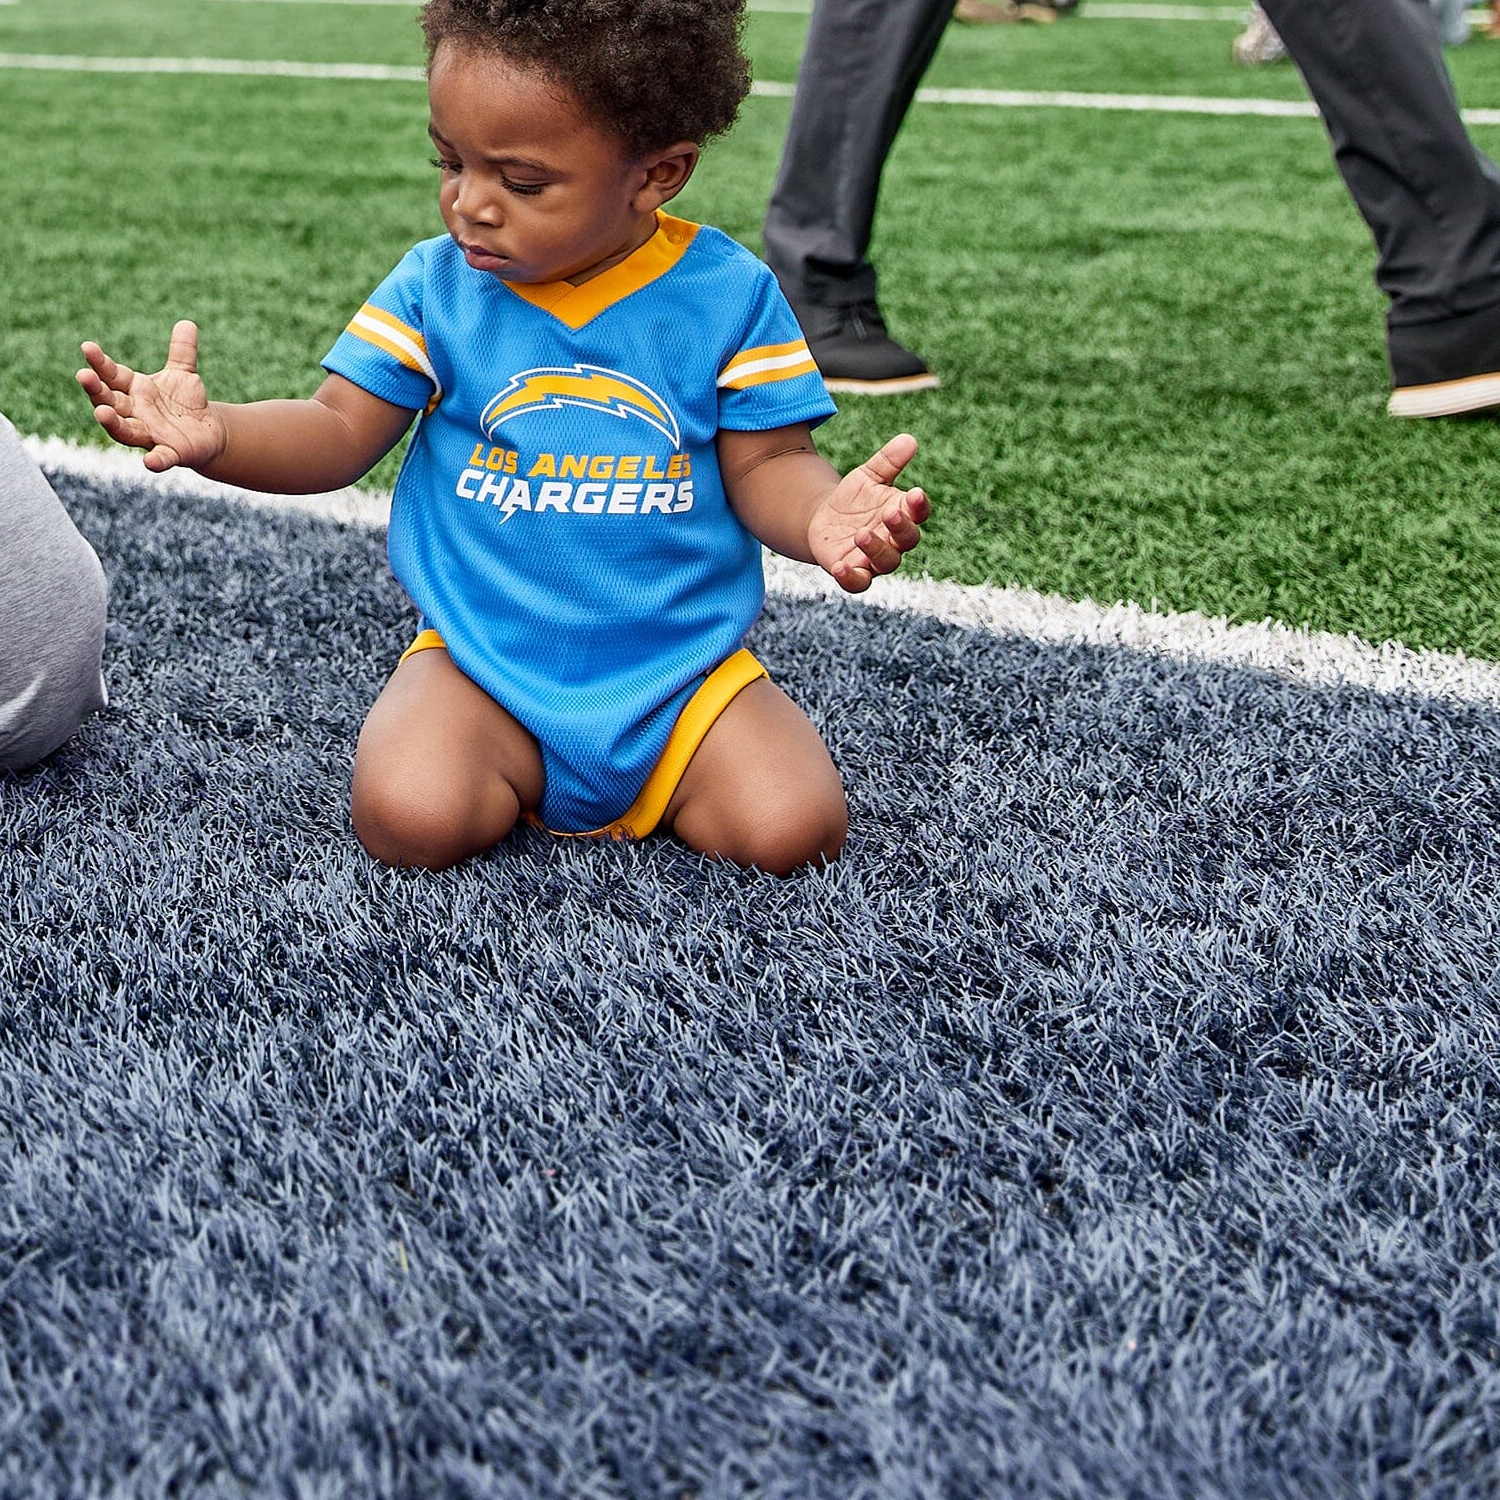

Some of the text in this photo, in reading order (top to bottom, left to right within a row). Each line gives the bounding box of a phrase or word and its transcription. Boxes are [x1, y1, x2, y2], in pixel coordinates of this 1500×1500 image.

[468, 443, 691, 479] LOS ANGELES
[455, 468, 694, 525] CHARGERS
